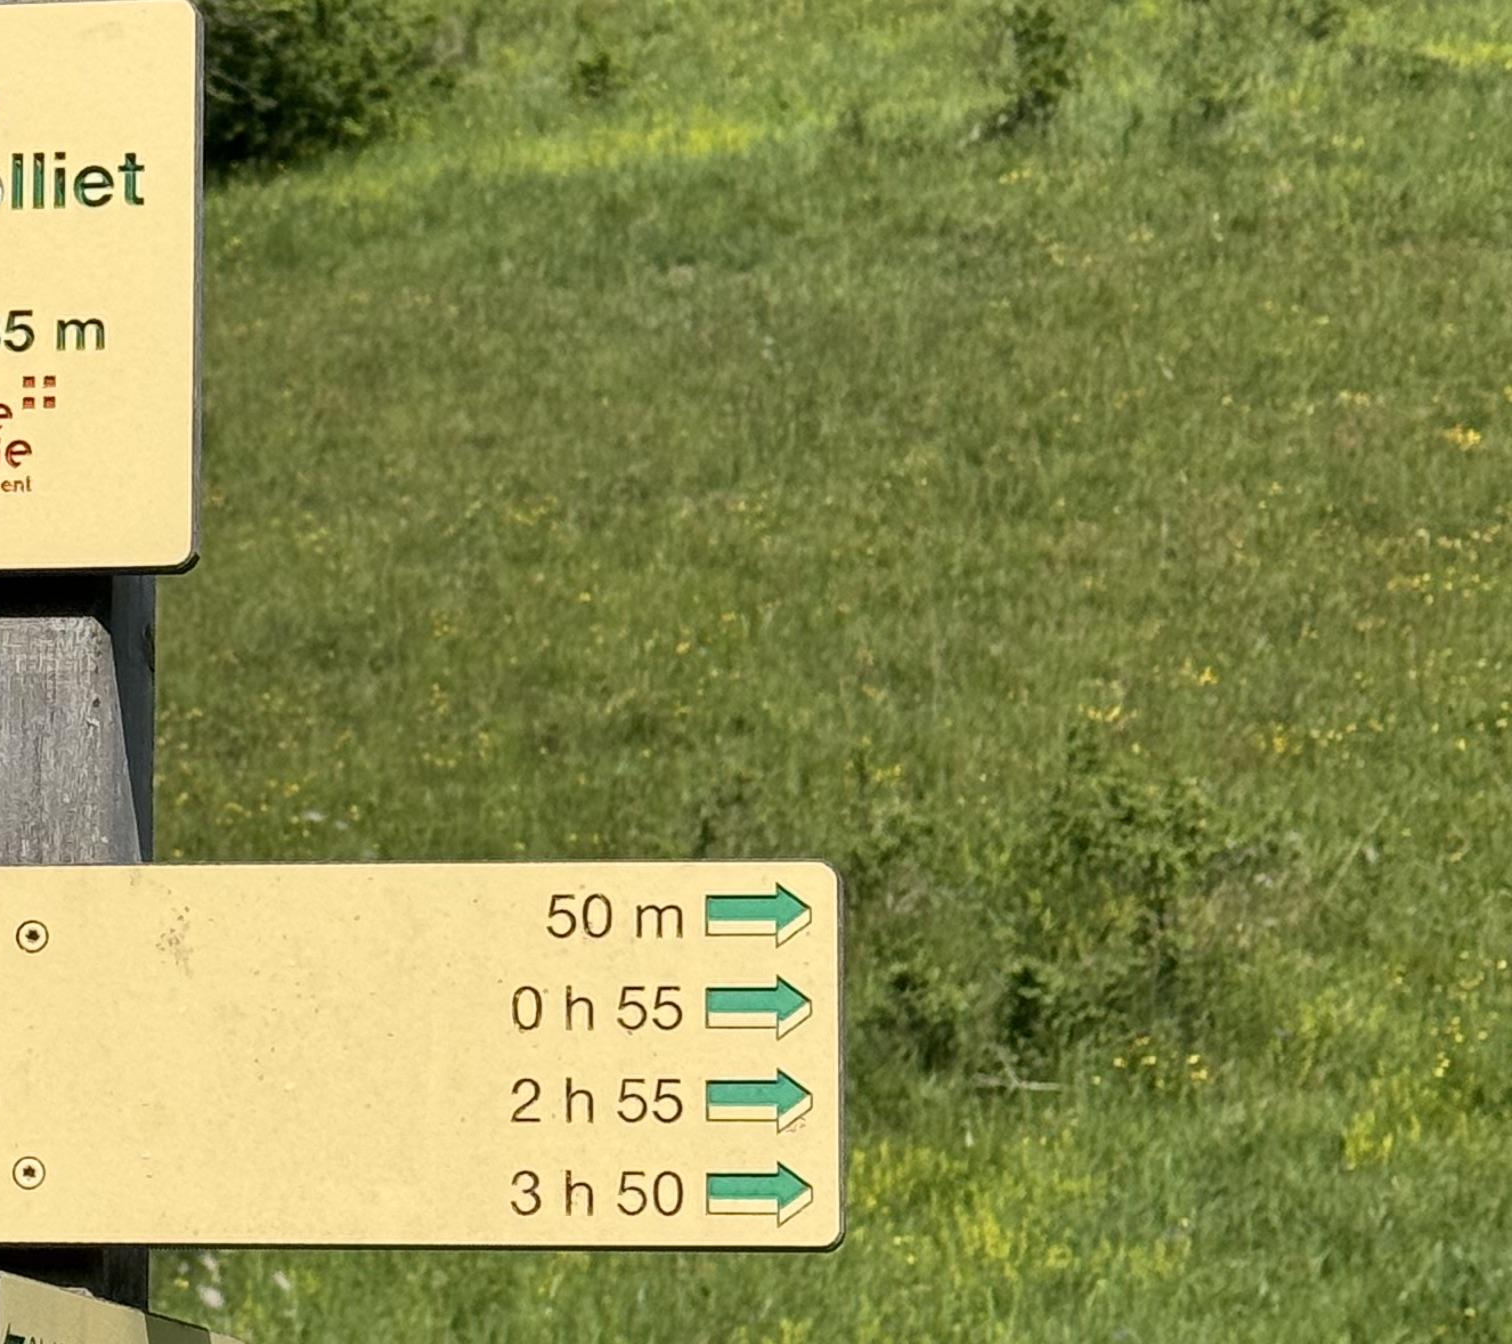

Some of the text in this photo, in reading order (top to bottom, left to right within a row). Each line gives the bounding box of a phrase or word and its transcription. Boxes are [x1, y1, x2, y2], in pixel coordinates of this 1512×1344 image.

[55, 316, 107, 351] m
[545, 892, 684, 939] 50 m
[511, 985, 684, 1032] 0 h 55
[510, 1077, 684, 1124] 2 h 55
[510, 1170, 684, 1217] 3 h 50
